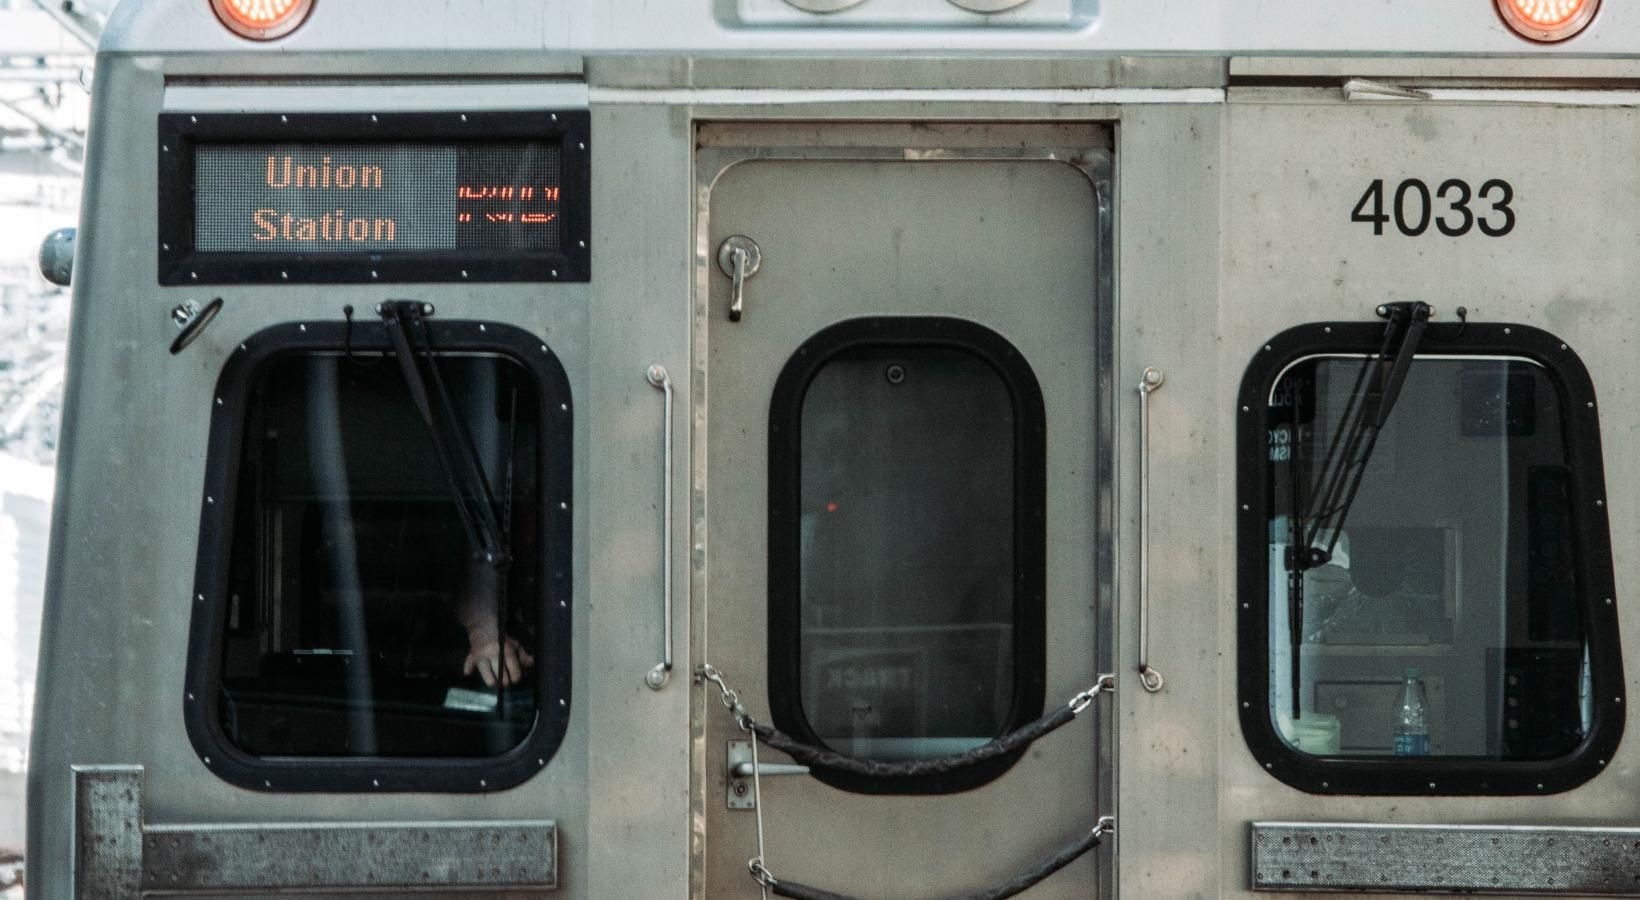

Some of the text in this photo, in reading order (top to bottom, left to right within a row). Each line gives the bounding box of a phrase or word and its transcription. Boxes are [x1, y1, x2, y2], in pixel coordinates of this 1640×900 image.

[267, 156, 382, 188] Union
[1351, 178, 1515, 237] 4033
[254, 209, 395, 240] Station
